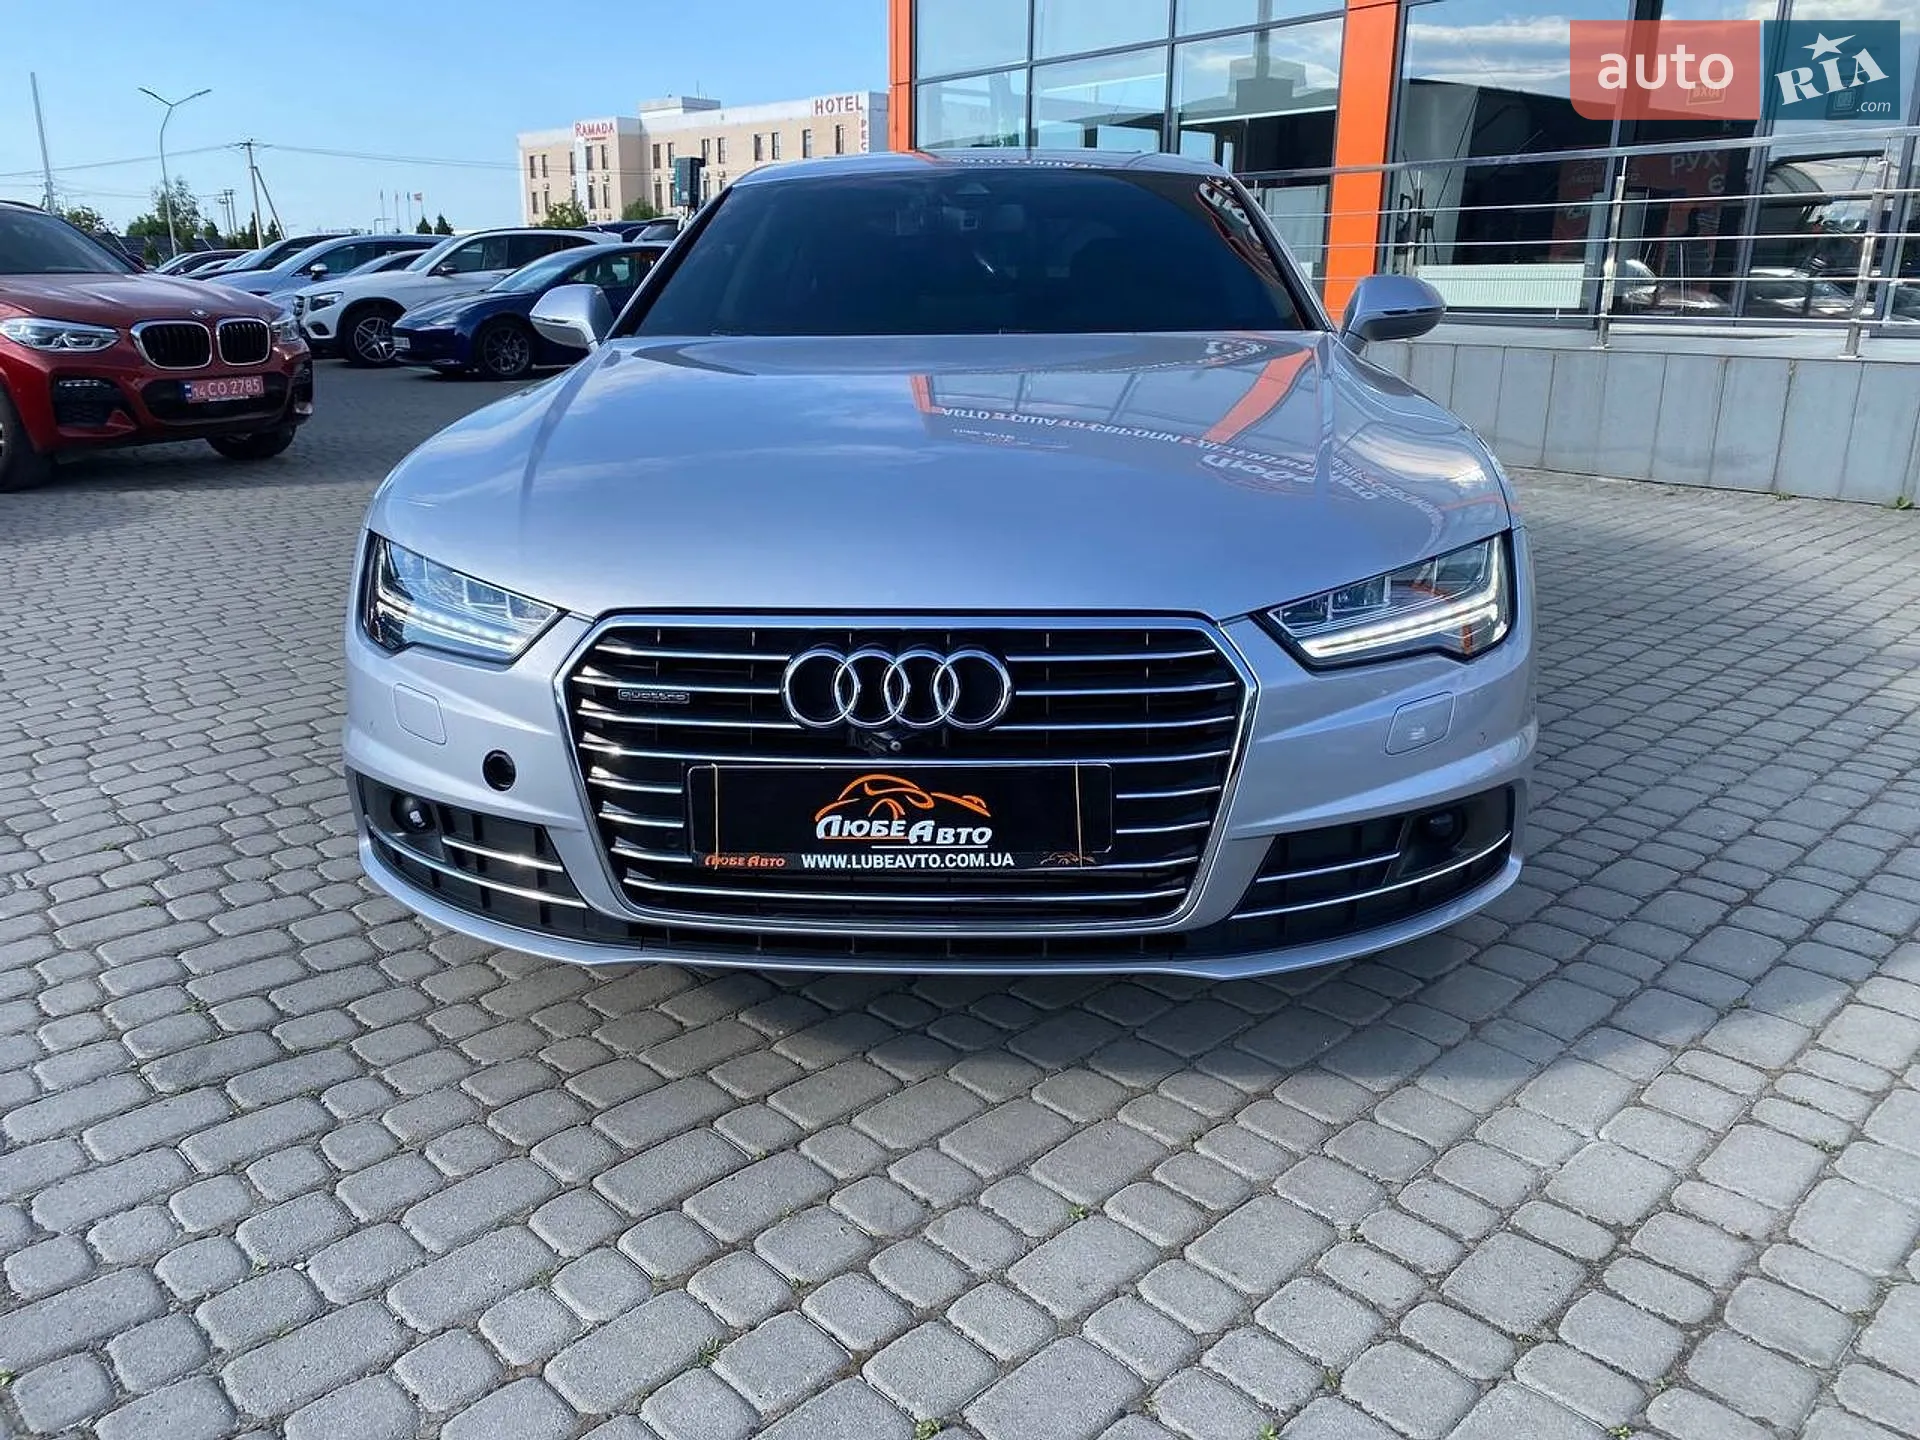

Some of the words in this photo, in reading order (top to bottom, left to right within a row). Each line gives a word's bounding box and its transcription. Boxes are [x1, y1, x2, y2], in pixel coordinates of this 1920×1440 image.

[814, 94, 864, 116] HOTEL
[575, 122, 615, 137] RAMADA
[802, 853, 1015, 870] WWW.LUBEAVTO.COM.UA
